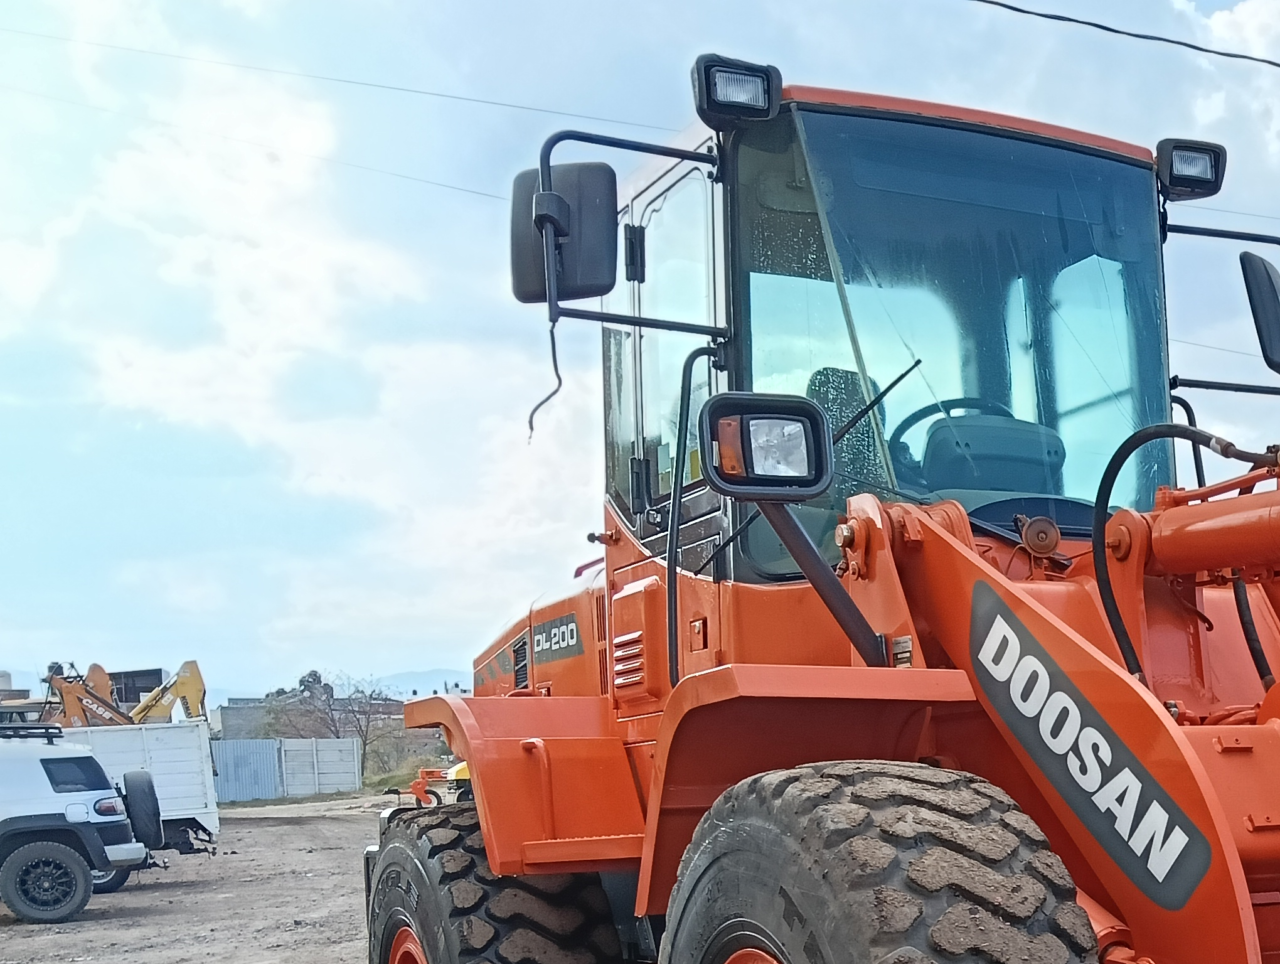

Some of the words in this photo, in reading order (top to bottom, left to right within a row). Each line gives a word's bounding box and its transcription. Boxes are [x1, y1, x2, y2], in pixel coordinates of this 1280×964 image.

[534, 622, 577, 652] DL200
[82, 698, 113, 720] CASE
[977, 613, 1190, 883] DOOSAN
